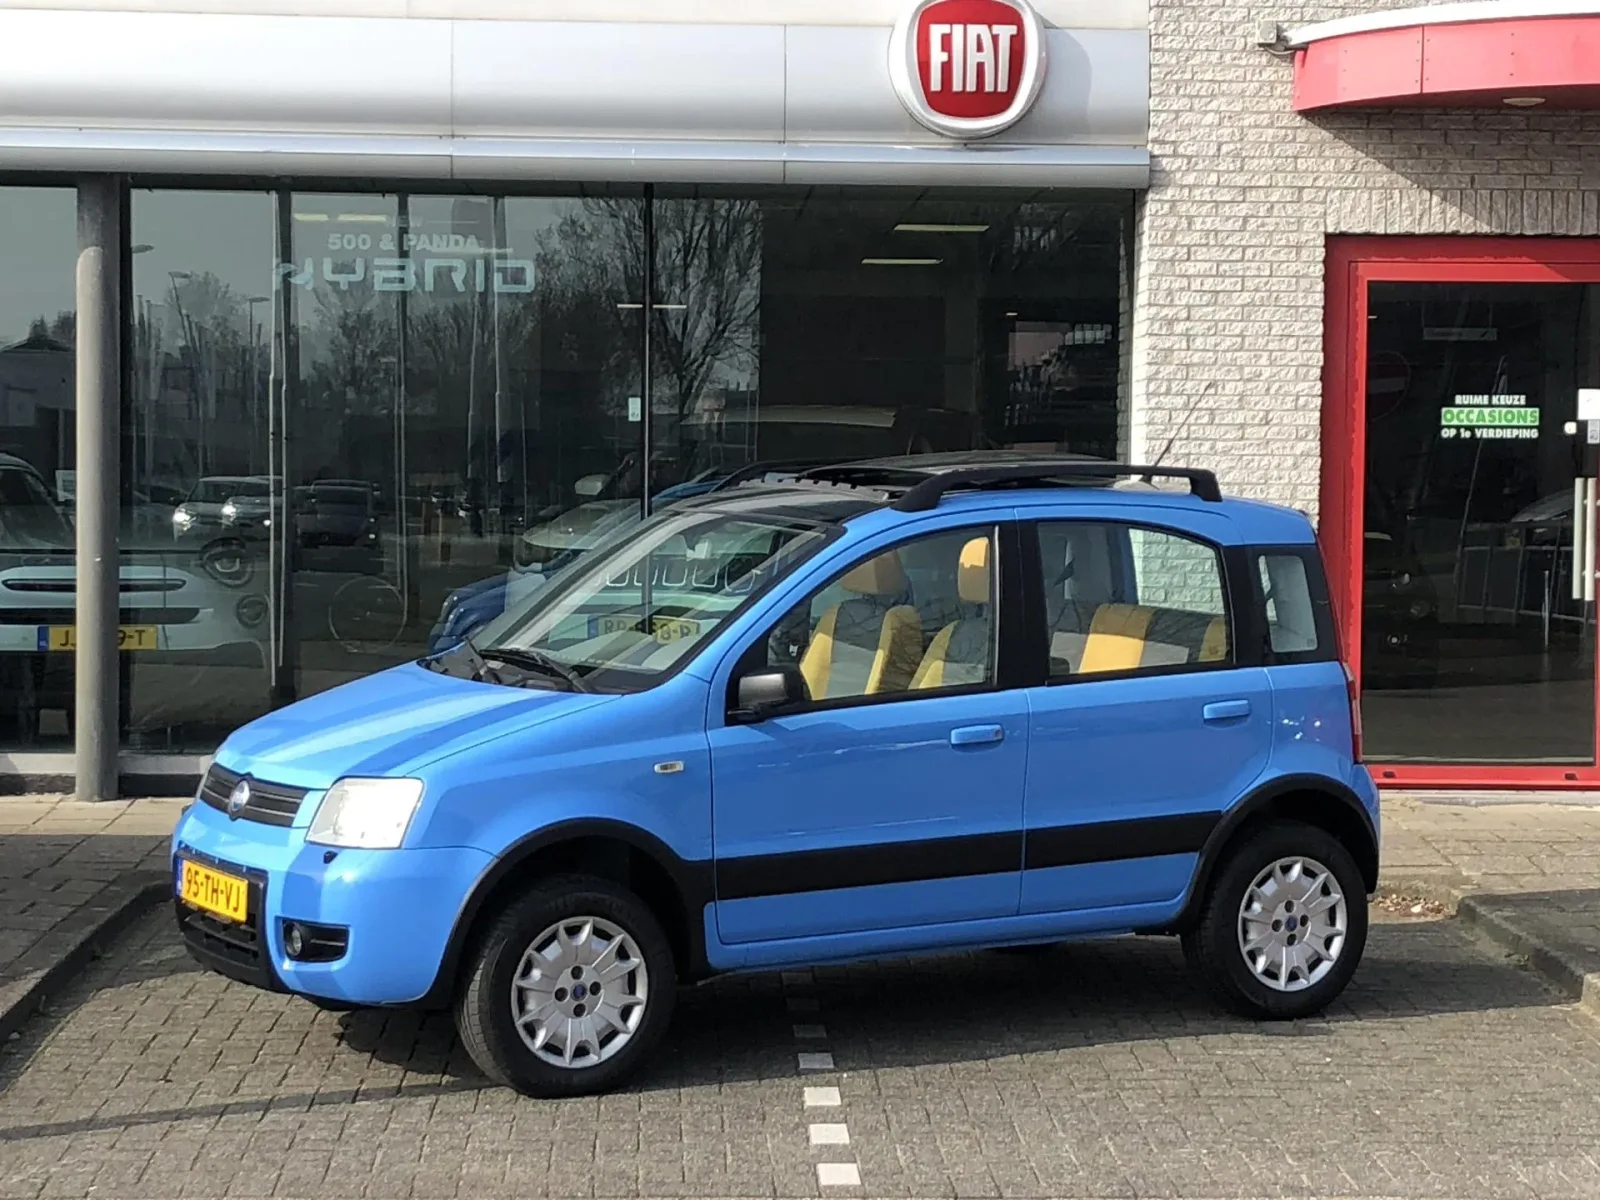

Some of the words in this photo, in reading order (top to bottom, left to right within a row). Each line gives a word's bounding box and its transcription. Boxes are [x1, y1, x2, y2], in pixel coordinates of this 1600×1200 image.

[929, 23, 1018, 92] FIAT
[328, 233, 371, 250] 500
[379, 233, 396, 250] &
[404, 233, 480, 250] PANDA
[1455, 394, 1490, 405] RUIME
[1491, 394, 1527, 405] KEUZE
[1442, 408, 1539, 424] OCCASIONS
[1440, 428, 1457, 438] OP
[1474, 428, 1539, 438] VERDIEPING
[186, 866, 241, 913] 95-TH-VJ
